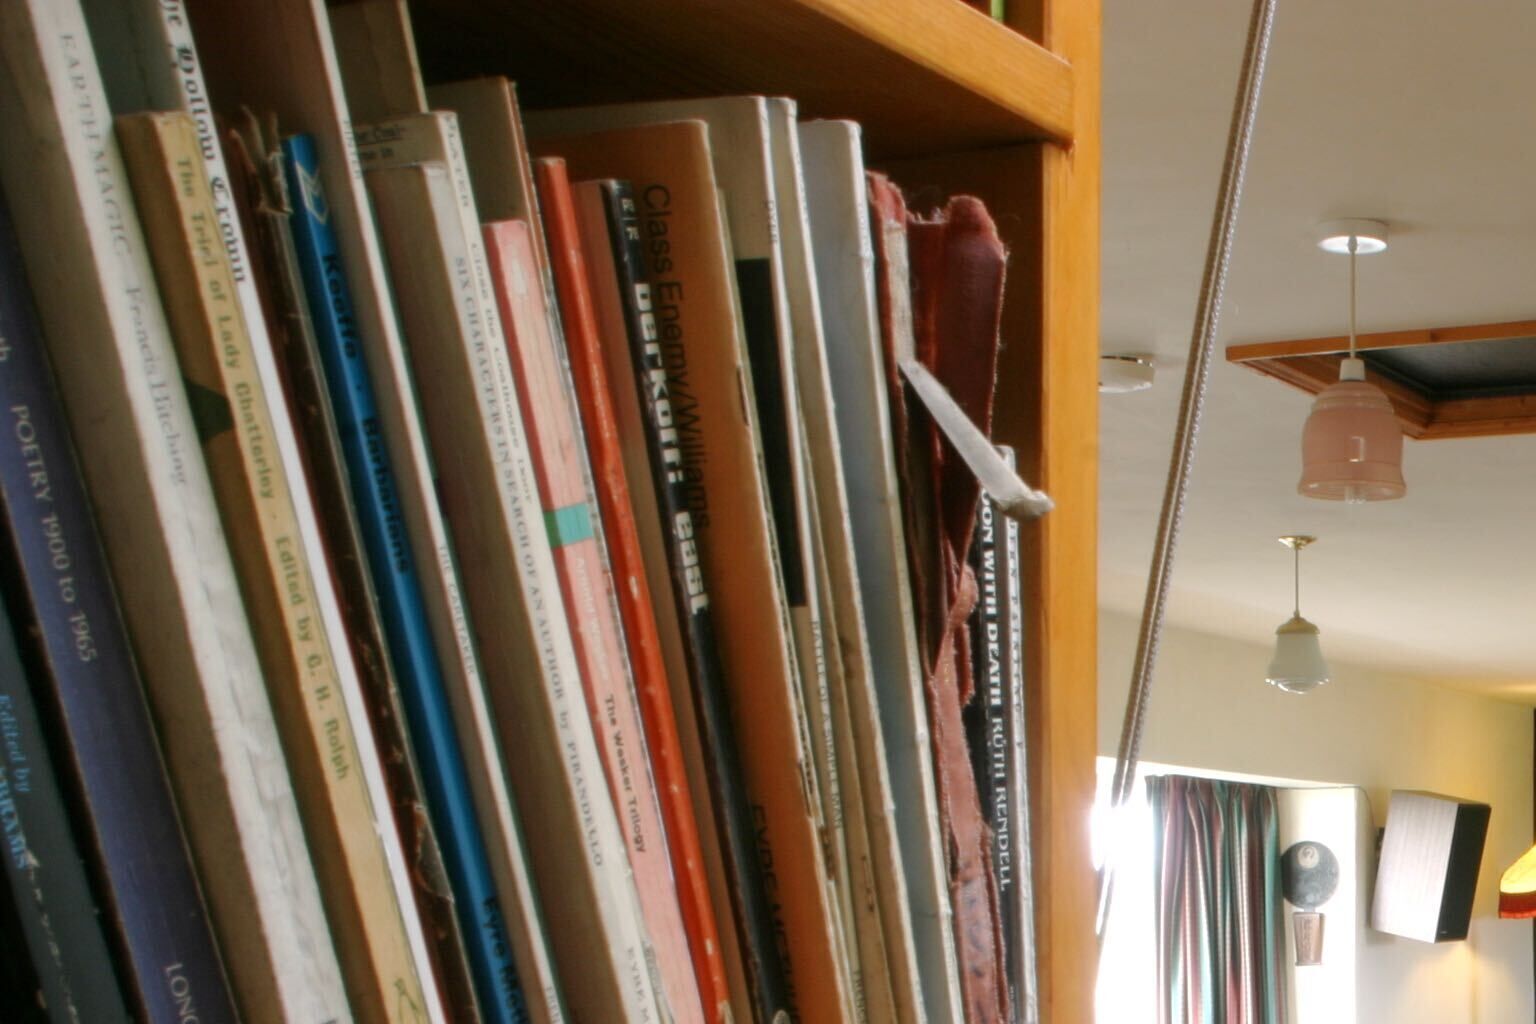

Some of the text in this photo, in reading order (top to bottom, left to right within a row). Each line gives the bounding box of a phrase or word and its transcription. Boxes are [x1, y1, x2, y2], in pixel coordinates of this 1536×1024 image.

[172, 44, 217, 163] Hollow
[210, 175, 250, 286] Crown
[174, 155, 199, 198] The
[61, 33, 193, 488] EARTH MAGIC Francis Hitching
[189, 210, 218, 268] Trial
[207, 277, 227, 305] of
[324, 253, 359, 361] Keeffe
[483, 307, 499, 337] the
[213, 313, 244, 371] Lady
[643, 184, 710, 529] Class Enemy/Williams
[233, 382, 278, 501] Chatterley
[8, 402, 99, 664] POETRY 1900 to 1965
[452, 256, 605, 868] SIX CHARACTERS IN SEARCH OF AN AUTHOR by PIRANDELLO
[673, 512, 709, 614] east
[273, 534, 307, 606] Edited
[981, 549, 998, 613] WITH
[292, 615, 316, 644] by
[985, 622, 1002, 705] DEATH
[313, 684, 334, 709] H.
[15, 766, 31, 793] by
[321, 717, 353, 781] Rolph
[601, 693, 649, 854] The Wesker Trilogy
[990, 716, 1012, 890] RUTH RENDELL
[476, 895, 511, 960] Eyre
